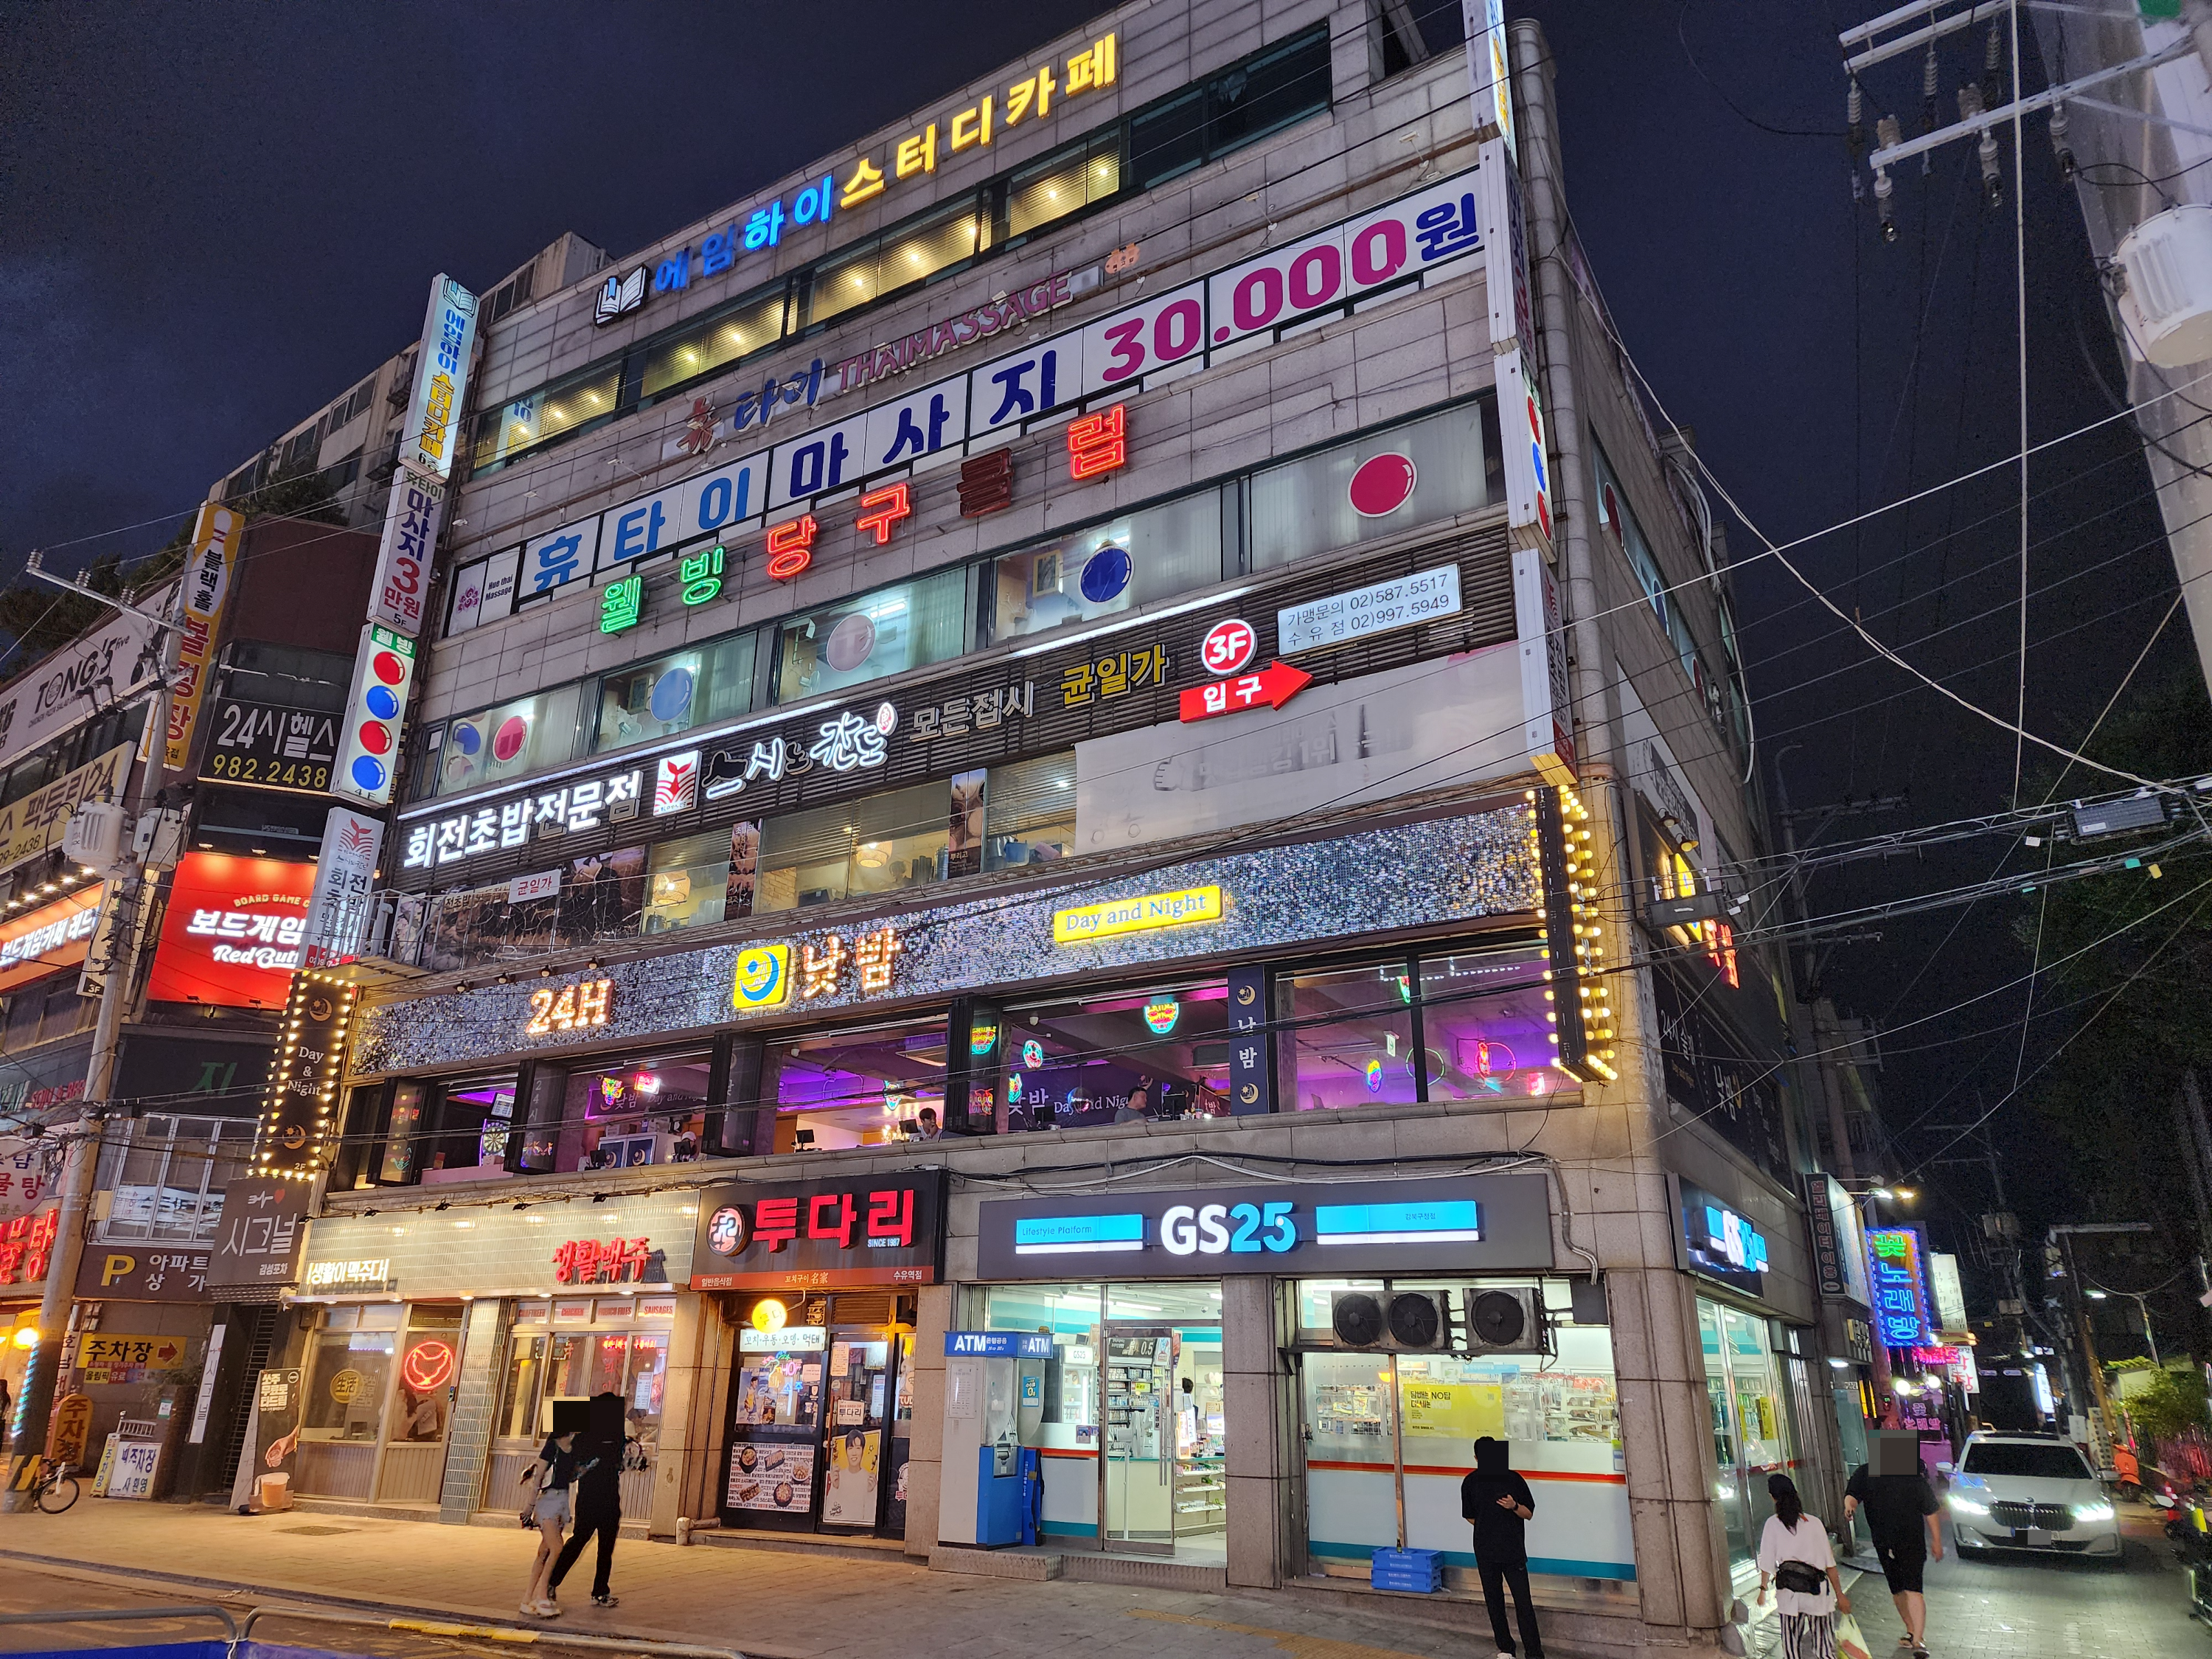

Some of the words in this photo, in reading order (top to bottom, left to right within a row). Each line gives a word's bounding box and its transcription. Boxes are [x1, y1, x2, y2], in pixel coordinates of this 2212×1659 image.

[655, 175, 832, 293] 에임하이
[840, 32, 1116, 209] 스터디카페
[1102, 192, 1479, 382] 30.000원
[437, 308, 465, 375] 에임하이
[419, 371, 455, 460] 스터디카페
[418, 452, 439, 473] 6층
[406, 470, 442, 500] 휴타이
[397, 487, 434, 562] 마사지
[600, 544, 726, 635] 웰빙
[767, 403, 1127, 580] 당구클럽
[192, 549, 223, 612] 블랙홀
[392, 557, 420, 594] 3
[488, 581, 500, 590] Hue
[501, 574, 513, 585] thai
[383, 585, 420, 620] 만원
[484, 586, 512, 602] Massage
[1287, 599, 1345, 627] 가맹문의
[1349, 573, 1448, 611] 02)587.5517
[393, 612, 407, 627] 5F
[1350, 594, 1450, 631] 02)997.5949
[374, 625, 414, 656] 웰빙
[1208, 631, 1250, 664] 3F
[911, 681, 1034, 742] 모든접시
[1060, 644, 1169, 707] 균일가
[1203, 678, 1263, 713] 입구
[217, 703, 335, 762] 24시헬스
[212, 753, 328, 790] 982.2438
[403, 771, 644, 869] 회전초밥전문점
[328, 867, 367, 894] 회전
[516, 876, 553, 897] 균일가
[233, 894, 269, 908] BOARD
[272, 894, 302, 905] GAME
[187, 908, 305, 946] 보드게임
[525, 978, 615, 1035] 24H
[802, 926, 904, 998] 낮밤
[1065, 913, 1102, 934] Day
[1107, 902, 1143, 924] and
[1148, 894, 1207, 922] Night
[88, 984, 101, 993] 3F
[298, 1046, 324, 1064] Day
[302, 1065, 312, 1077] &
[287, 1079, 321, 1098] Night
[294, 1162, 306, 1171] 2F
[752, 1189, 914, 1253] 투다리
[1022, 1224, 1056, 1237] Lifestyle
[1057, 1223, 1092, 1235] Platform
[1160, 1202, 1296, 1256] GS25
[1405, 1212, 1437, 1221] 강북구청점
[221, 1212, 298, 1257] 시그널
[867, 1238, 886, 1248] SINCE
[887, 1237, 901, 1247] 1987
[100, 1254, 136, 1287] P
[149, 1254, 209, 1273] 아파트
[259, 1262, 289, 1276] 감성포차
[550, 1237, 652, 1282] 생활맥주
[701, 1276, 733, 1287] 일반음식점
[785, 1275, 810, 1284] 꼬치구이
[811, 1272, 829, 1284] 名家
[893, 1269, 922, 1281] 수유역점
[644, 1305, 672, 1315] SAUSAGES
[85, 1340, 155, 1363] 주차장
[954, 1335, 986, 1352] ATM
[1027, 1337, 1050, 1354] ATM
[1073, 1350, 1087, 1360] GS25
[260, 1383, 288, 1397] 무료로
[838, 1407, 862, 1417] 투다리
